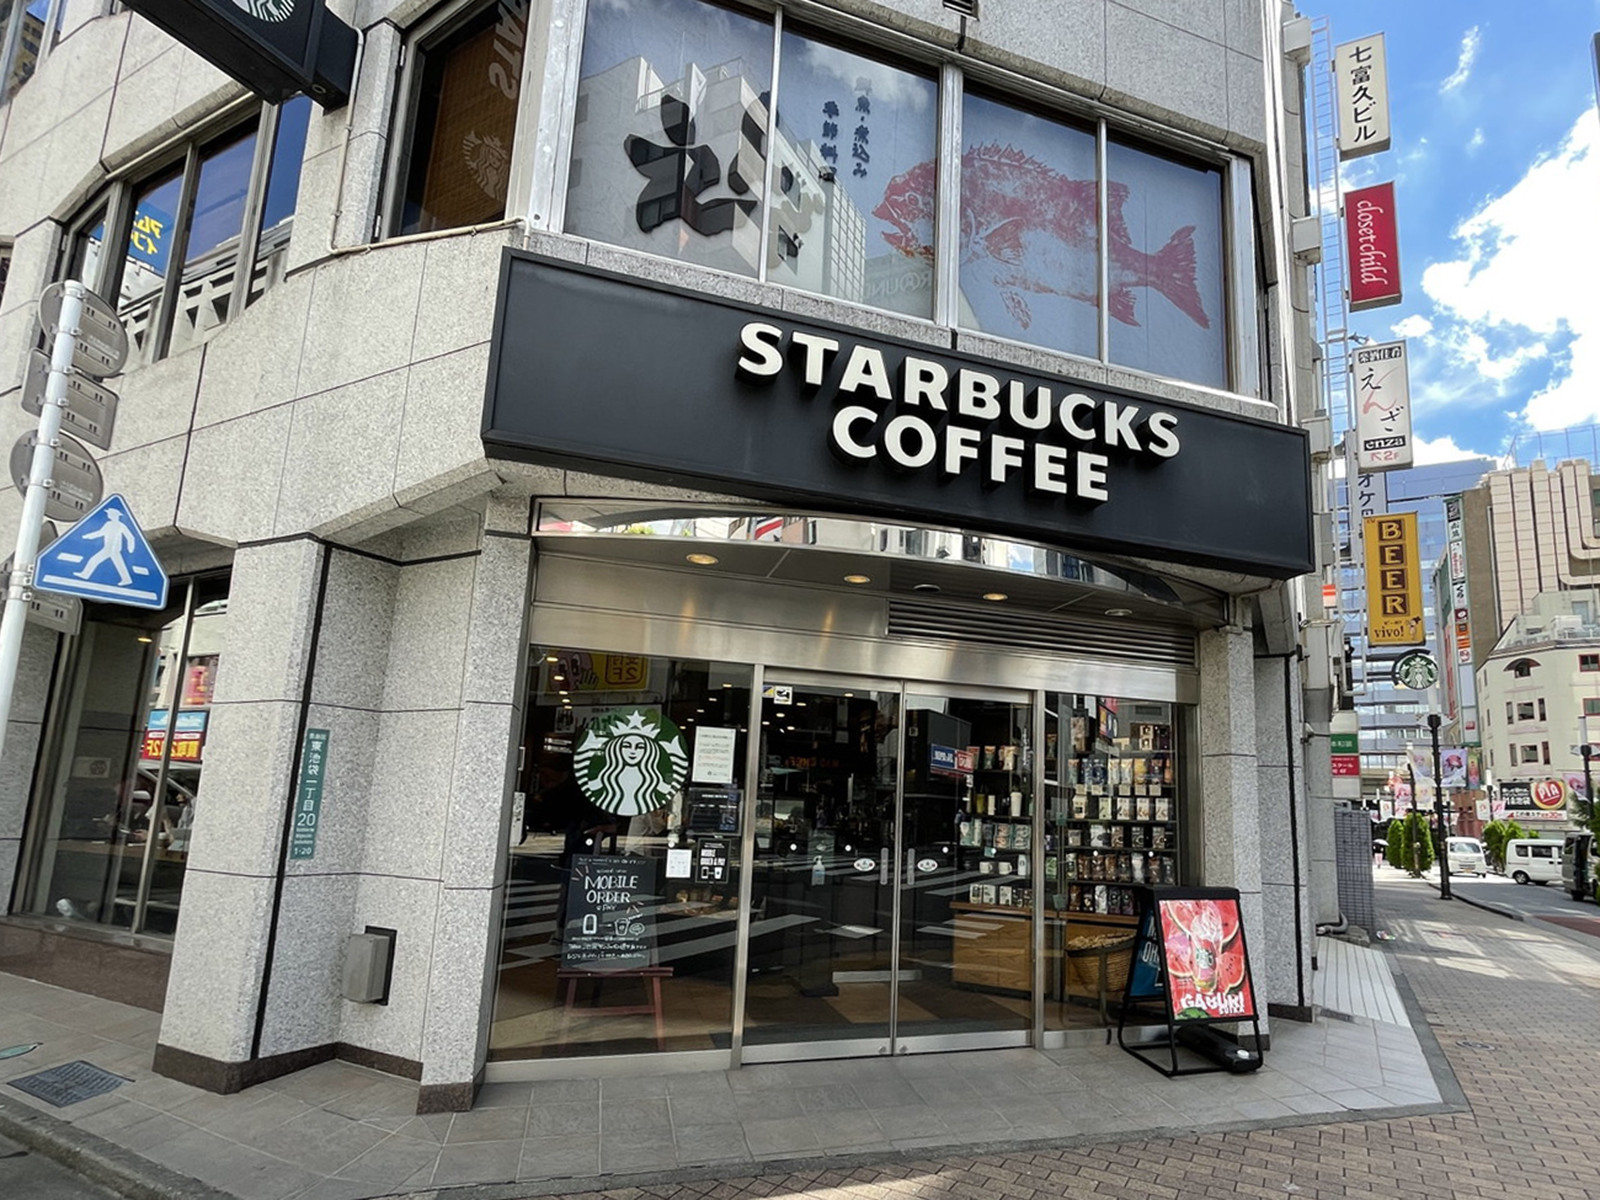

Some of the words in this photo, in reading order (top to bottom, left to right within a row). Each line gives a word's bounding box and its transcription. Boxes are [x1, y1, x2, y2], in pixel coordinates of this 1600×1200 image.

[1349, 46, 1376, 142] 七富久ビル
[738, 322, 1181, 458] STARBUCKS
[1361, 367, 1404, 432] えんざ
[832, 406, 1108, 501] COFFEE
[1365, 438, 1404, 450] enza
[1381, 522, 1405, 613] BEER
[1373, 625, 1404, 639] vivo!
[303, 741, 323, 811] 東池袋一丁目
[1538, 783, 1559, 800] PIA
[297, 812, 316, 826] 20
[585, 875, 639, 890] MOBILE
[586, 890, 631, 904] ORDER
